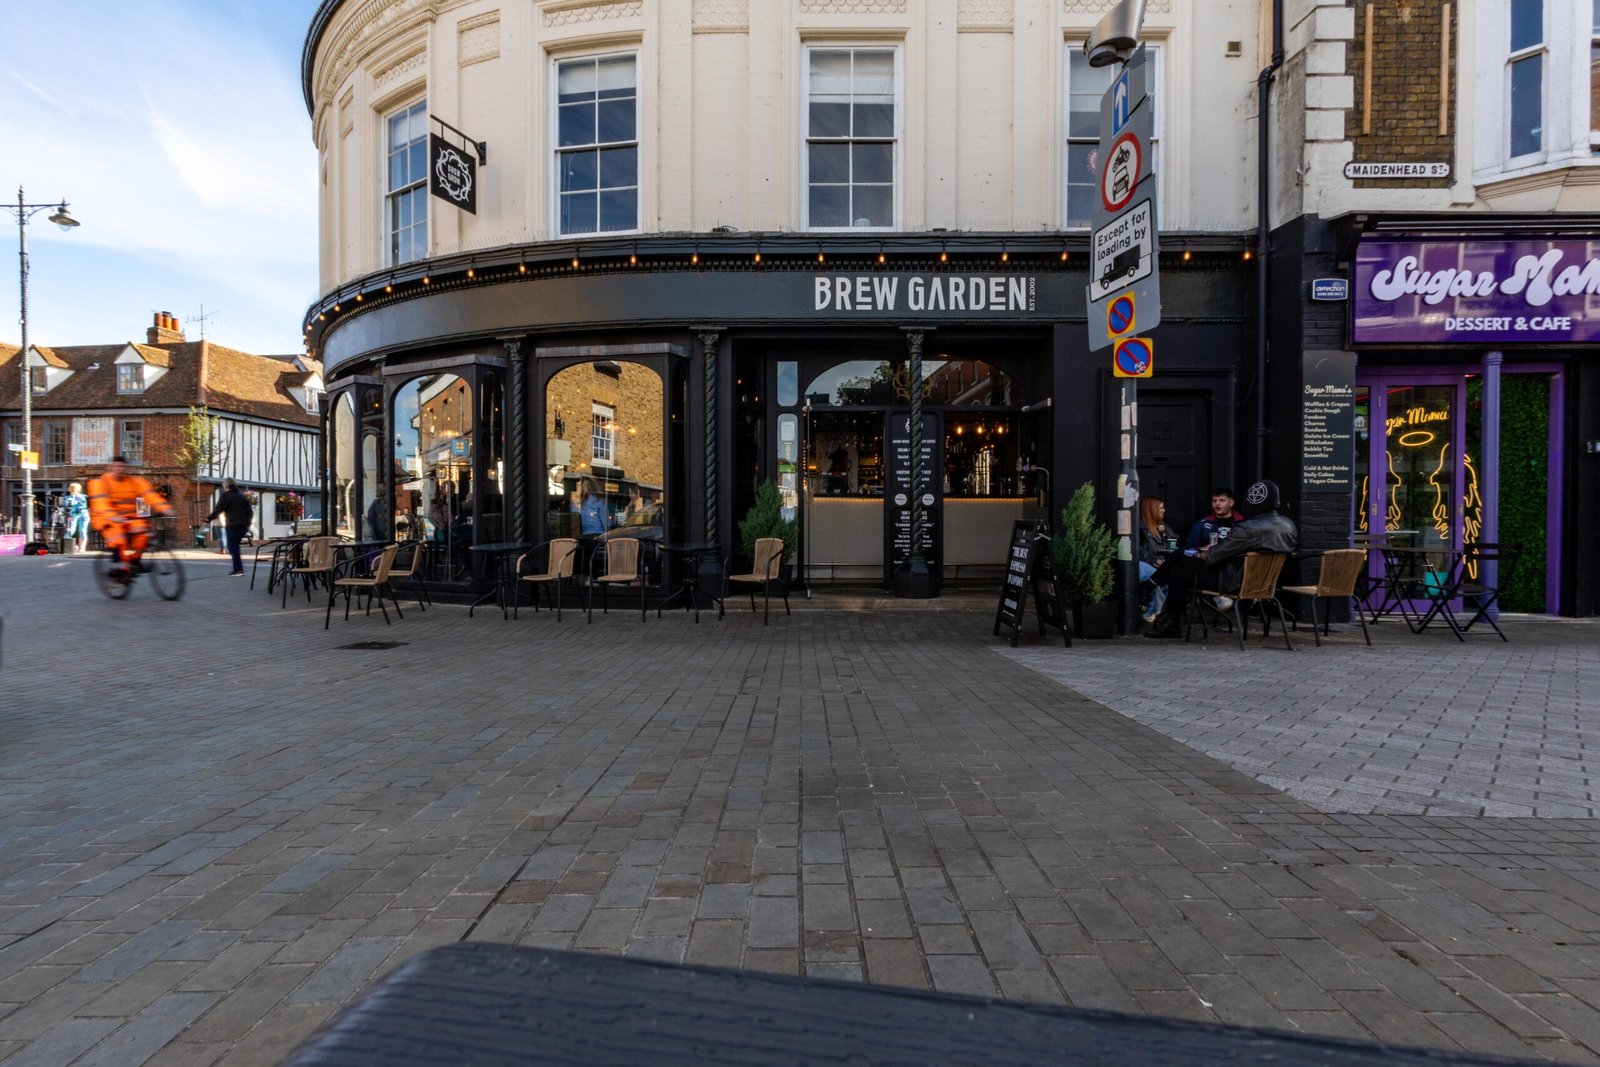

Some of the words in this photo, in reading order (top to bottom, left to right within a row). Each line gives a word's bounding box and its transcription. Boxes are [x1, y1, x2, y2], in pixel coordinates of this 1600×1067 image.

[1352, 165, 1426, 175] MAIDENHEAD
[1098, 221, 1129, 247] Except
[1131, 211, 1146, 226] for
[1098, 235, 1131, 261] loading
[1134, 226, 1147, 240] by
[1371, 255, 1498, 305] Sugar
[815, 277, 898, 310] BREW
[908, 277, 1027, 310] GARDEN
[1445, 317, 1512, 330] DESSERT
[1514, 317, 1529, 330] &
[1530, 317, 1571, 330] CAFE
[1304, 384, 1325, 397] Sugar
[1407, 407, 1448, 425] Mama
